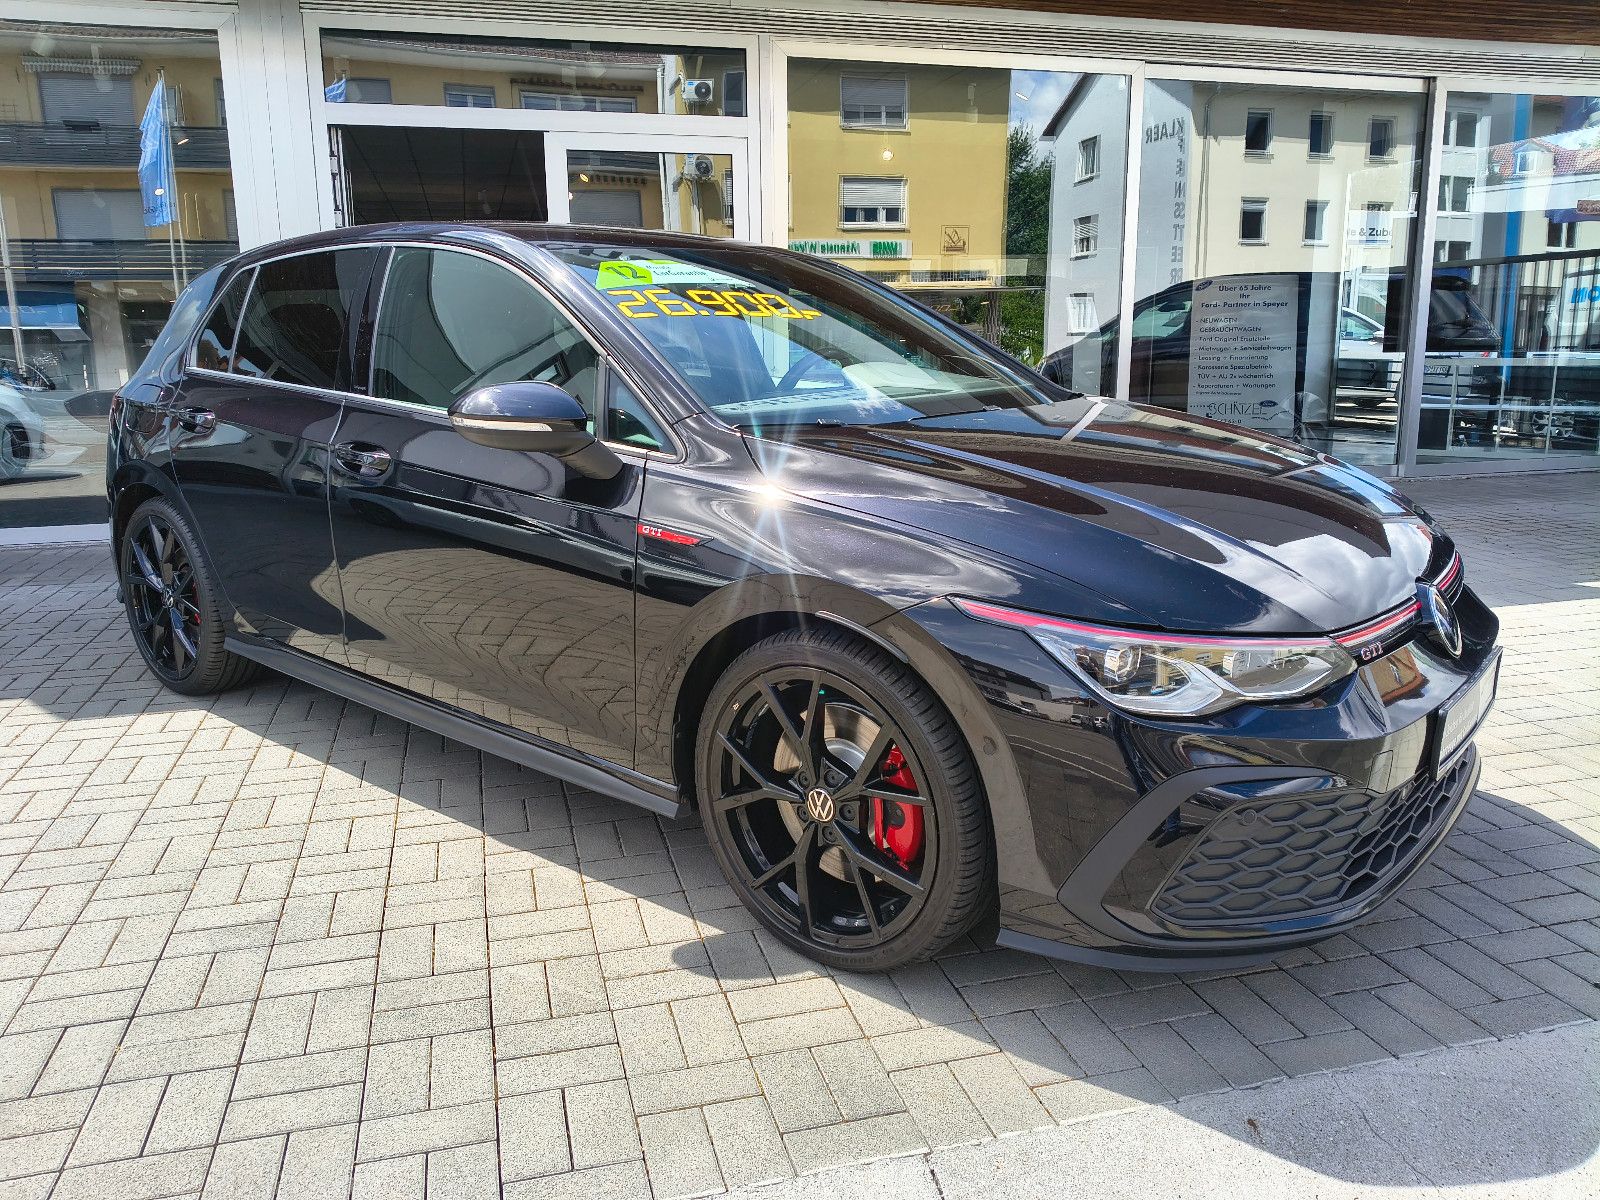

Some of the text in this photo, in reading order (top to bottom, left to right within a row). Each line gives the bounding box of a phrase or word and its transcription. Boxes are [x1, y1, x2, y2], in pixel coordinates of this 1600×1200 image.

[605, 265, 647, 280] 12
[642, 525, 663, 537] GTI
[1360, 641, 1384, 661] GTI
